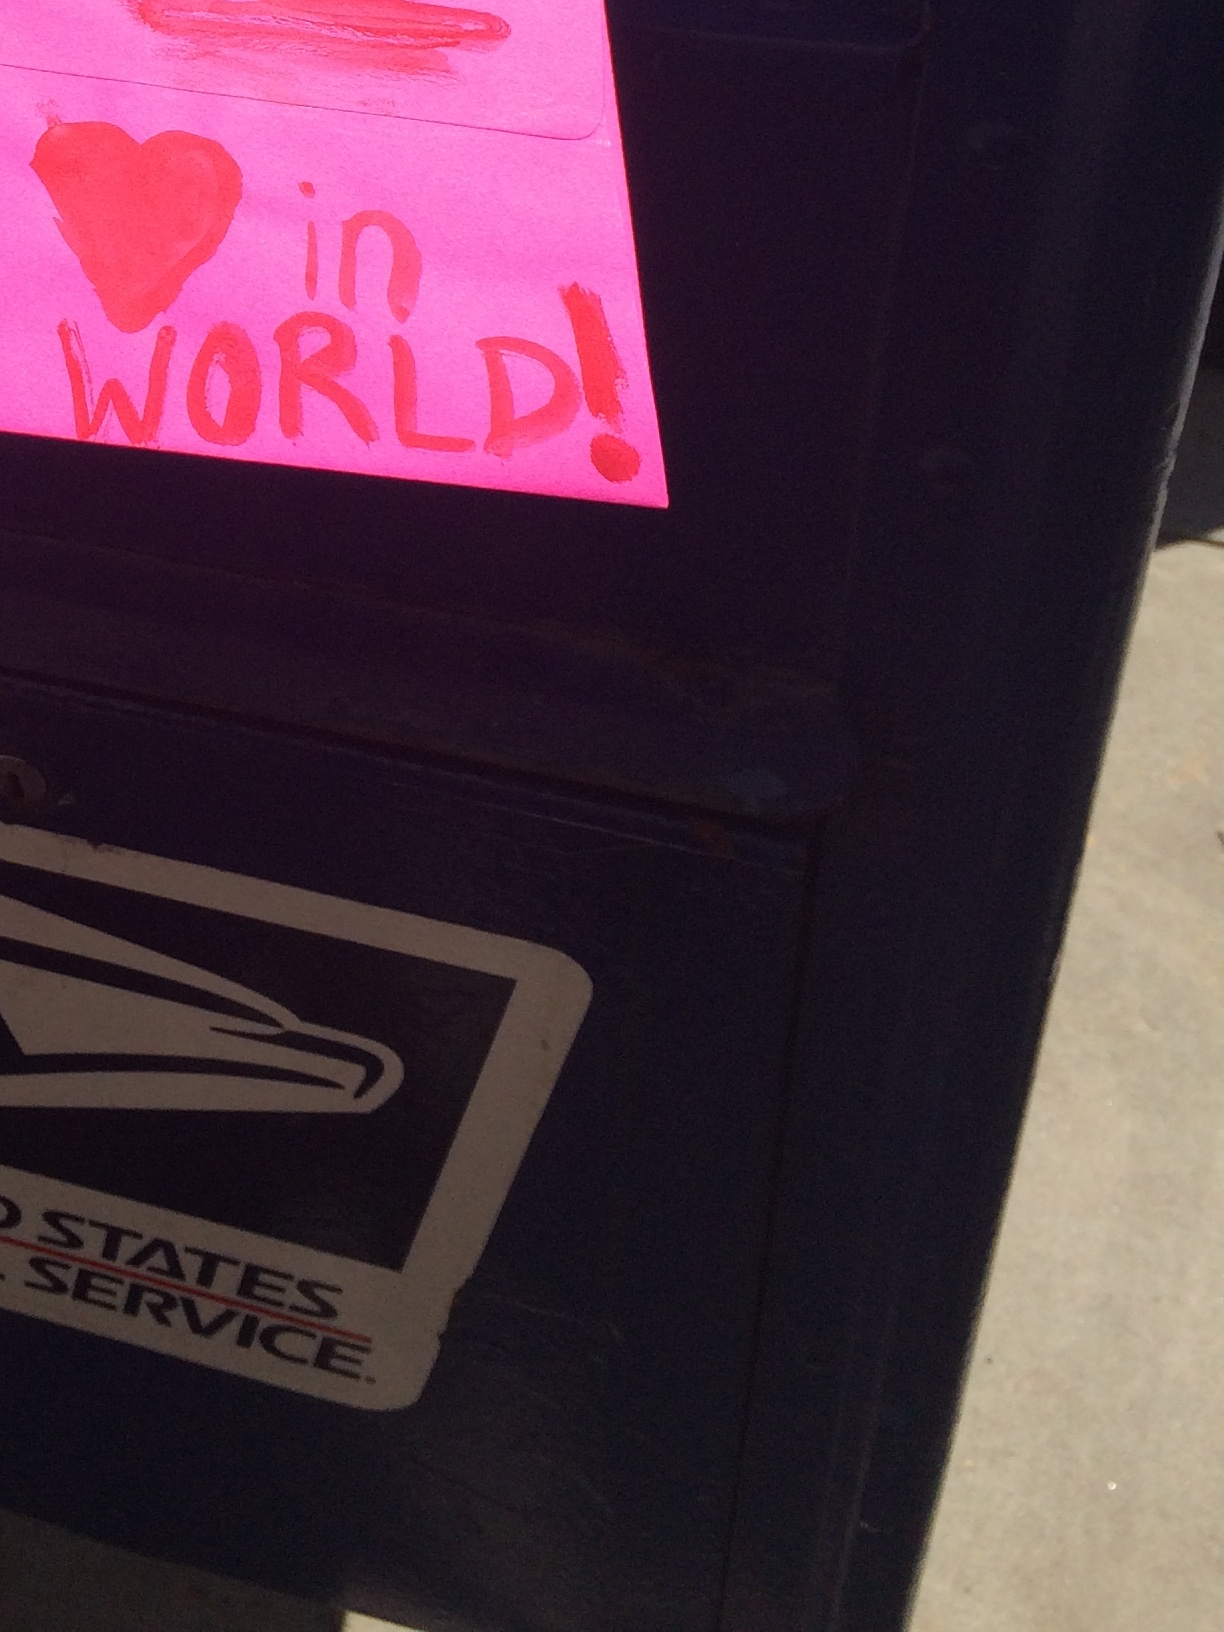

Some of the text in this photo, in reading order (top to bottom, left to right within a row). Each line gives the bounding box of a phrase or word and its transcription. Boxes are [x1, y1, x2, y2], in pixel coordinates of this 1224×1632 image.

[297, 180, 423, 323] in
[57, 280, 643, 484] WORLD!
[37, 1209, 344, 1322] STATES
